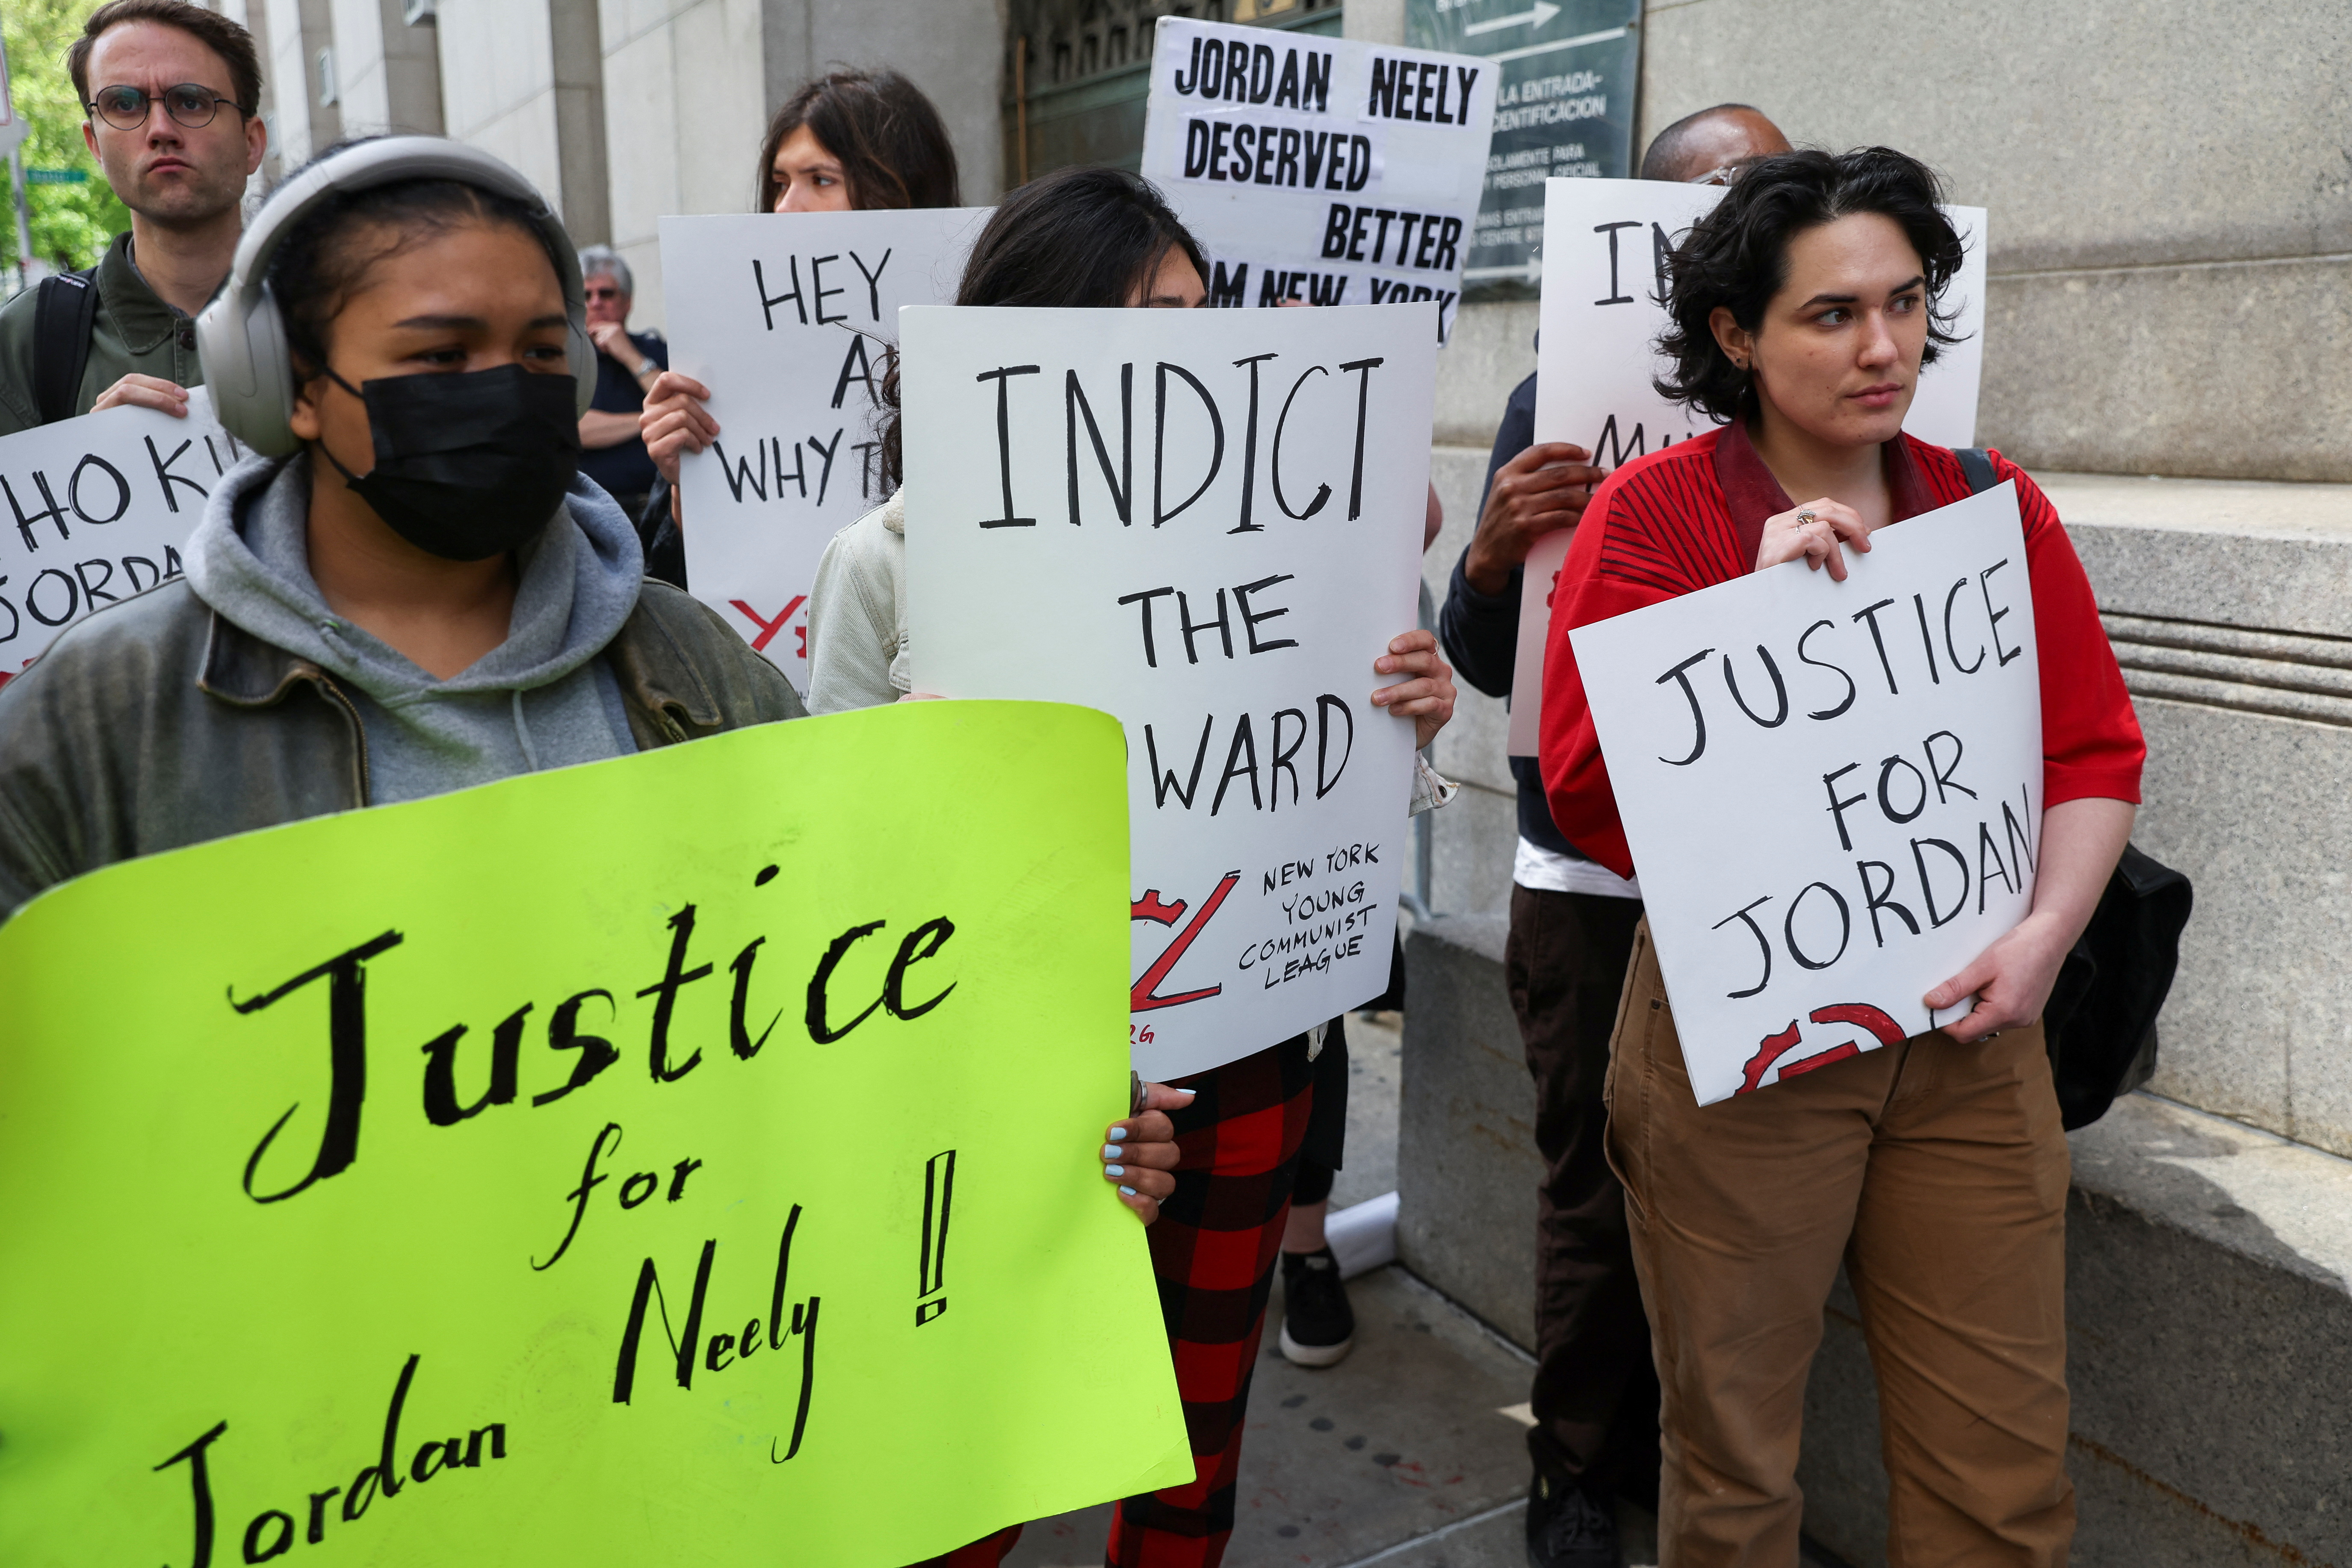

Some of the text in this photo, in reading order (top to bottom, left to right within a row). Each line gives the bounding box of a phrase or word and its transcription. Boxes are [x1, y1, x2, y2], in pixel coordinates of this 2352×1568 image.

[1175, 37, 1478, 125] JORDAN NEELY
[1184, 118, 1371, 192] DESERVED
[1321, 203, 1463, 272] BETTER
[753, 248, 891, 331] HEY
[831, 334, 899, 410] A
[713, 428, 844, 506] WHY
[976, 353, 1384, 534] INDICT
[1586, 414, 1693, 493] M
[1117, 574, 1300, 668] THE
[1655, 558, 2021, 766] JUSTICE
[1143, 693, 1354, 817] WARD
[1823, 730, 1978, 852] FOR
[1263, 842, 1380, 896] NEW YORK
[1282, 880, 1365, 926] YOUNG
[1711, 783, 2034, 999] JORDAN
[1238, 903, 1377, 970] COMMUNIST
[1265, 934, 1364, 990] LEAGUE
[229, 864, 957, 1204] Justice
[530, 1122, 702, 1271] for
[151, 1353, 506, 1568] Jordan
[612, 1204, 821, 1465] Neely
